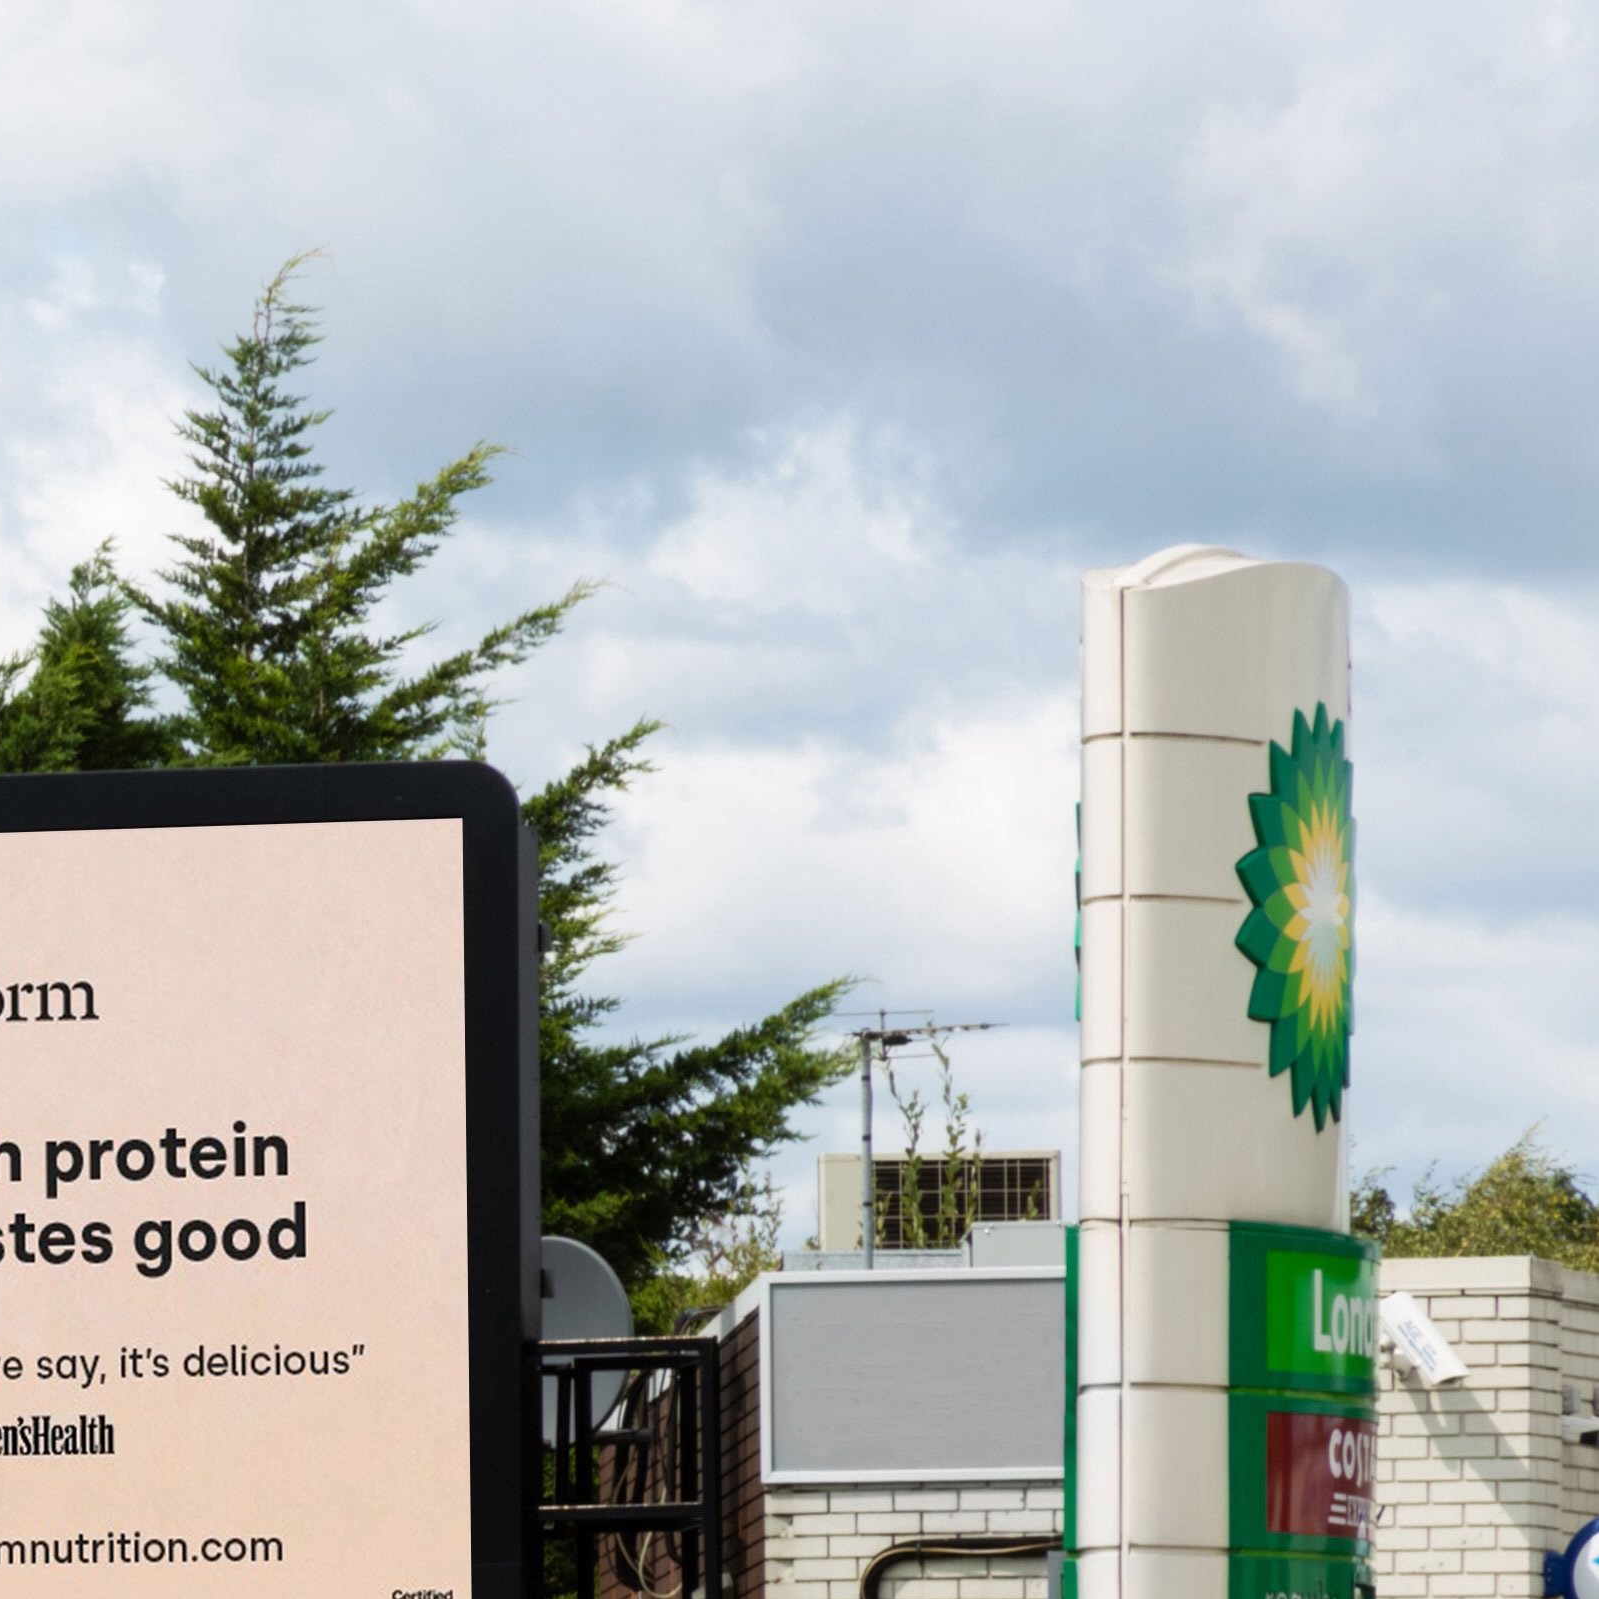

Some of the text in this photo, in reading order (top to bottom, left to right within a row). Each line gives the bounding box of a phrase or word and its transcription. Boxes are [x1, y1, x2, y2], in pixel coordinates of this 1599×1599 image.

[46, 1121, 290, 1198] protein
[134, 1201, 307, 1279] good
[37, 1355, 107, 1390] say,
[121, 1347, 171, 1379] it’s
